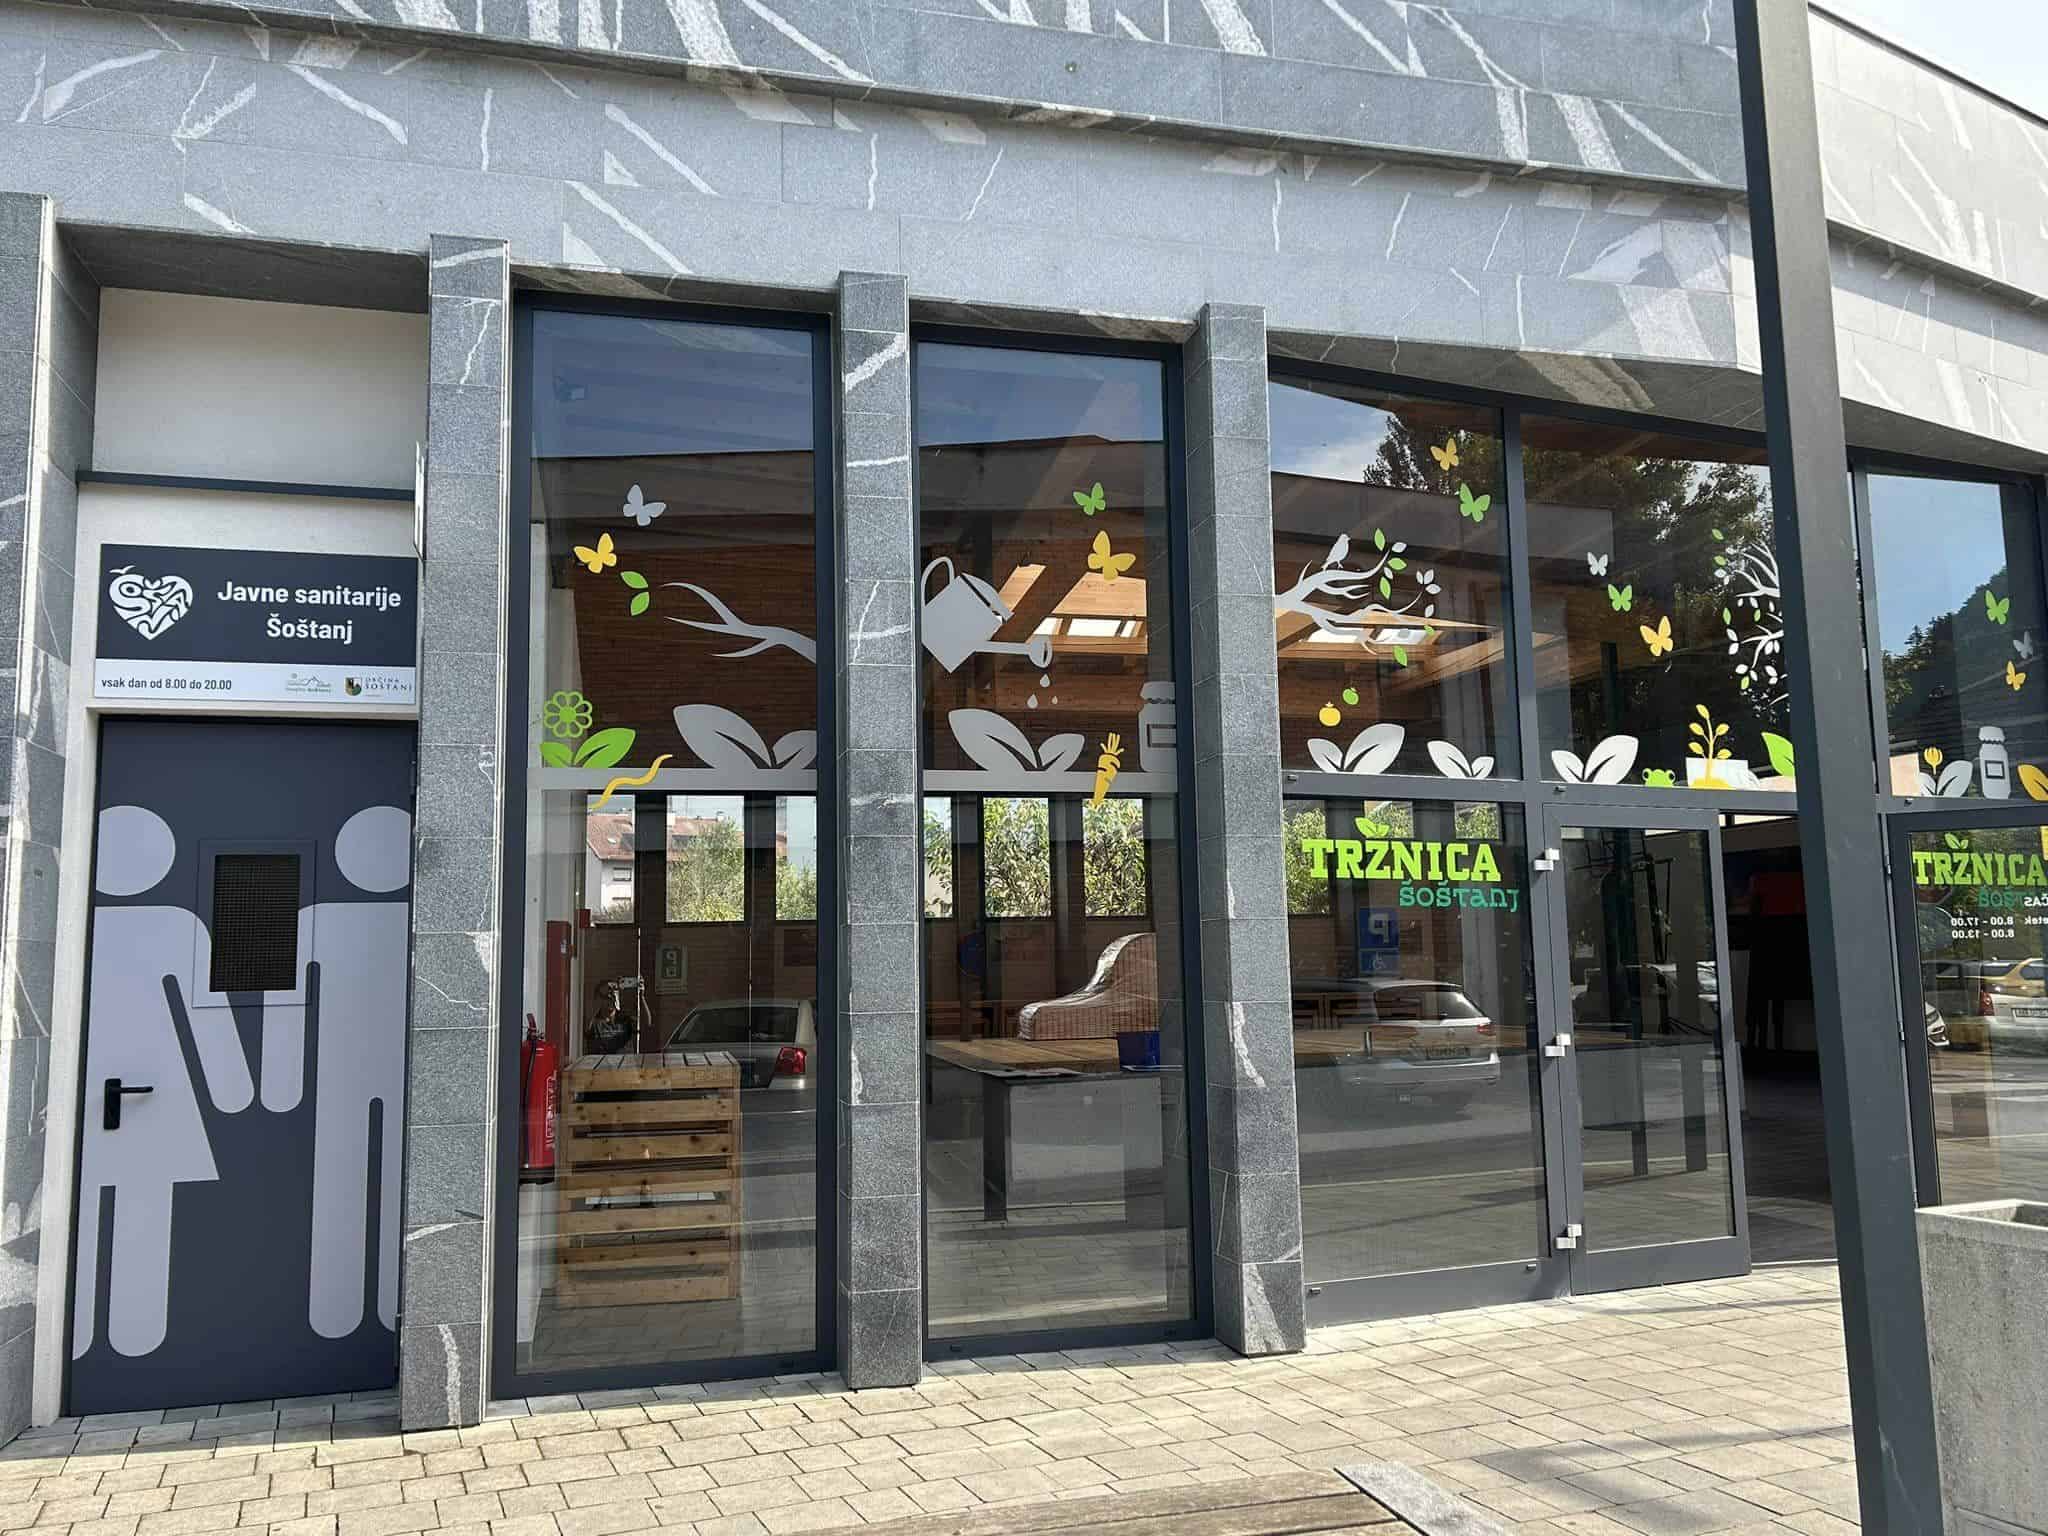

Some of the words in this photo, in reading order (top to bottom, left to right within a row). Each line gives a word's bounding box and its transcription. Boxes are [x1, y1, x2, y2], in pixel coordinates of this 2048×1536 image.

[217, 581, 288, 603] Javne
[295, 585, 401, 611] sanitarije
[266, 612, 353, 644] Šoštanj
[101, 677, 126, 689] vsak
[128, 677, 147, 689] dan
[150, 678, 162, 689] od
[165, 679, 187, 690] 8.00
[189, 679, 202, 690] do
[204, 680, 232, 691] 20.00
